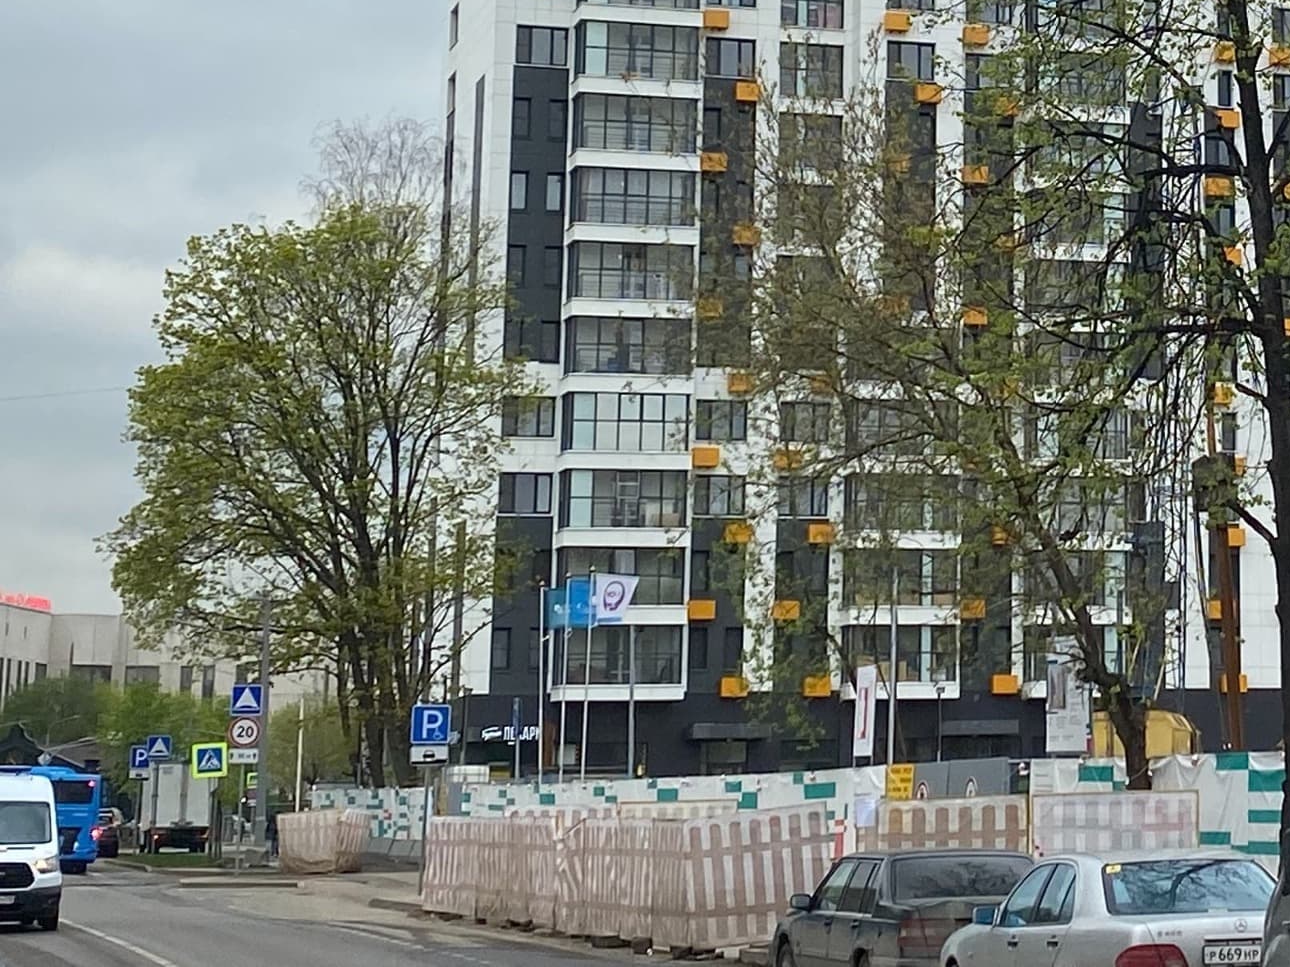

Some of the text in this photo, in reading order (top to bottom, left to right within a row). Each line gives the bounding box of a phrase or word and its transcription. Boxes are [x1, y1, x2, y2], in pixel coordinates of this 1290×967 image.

[236, 725, 255, 738] 20
[422, 709, 443, 739] P
[135, 748, 148, 767] P
